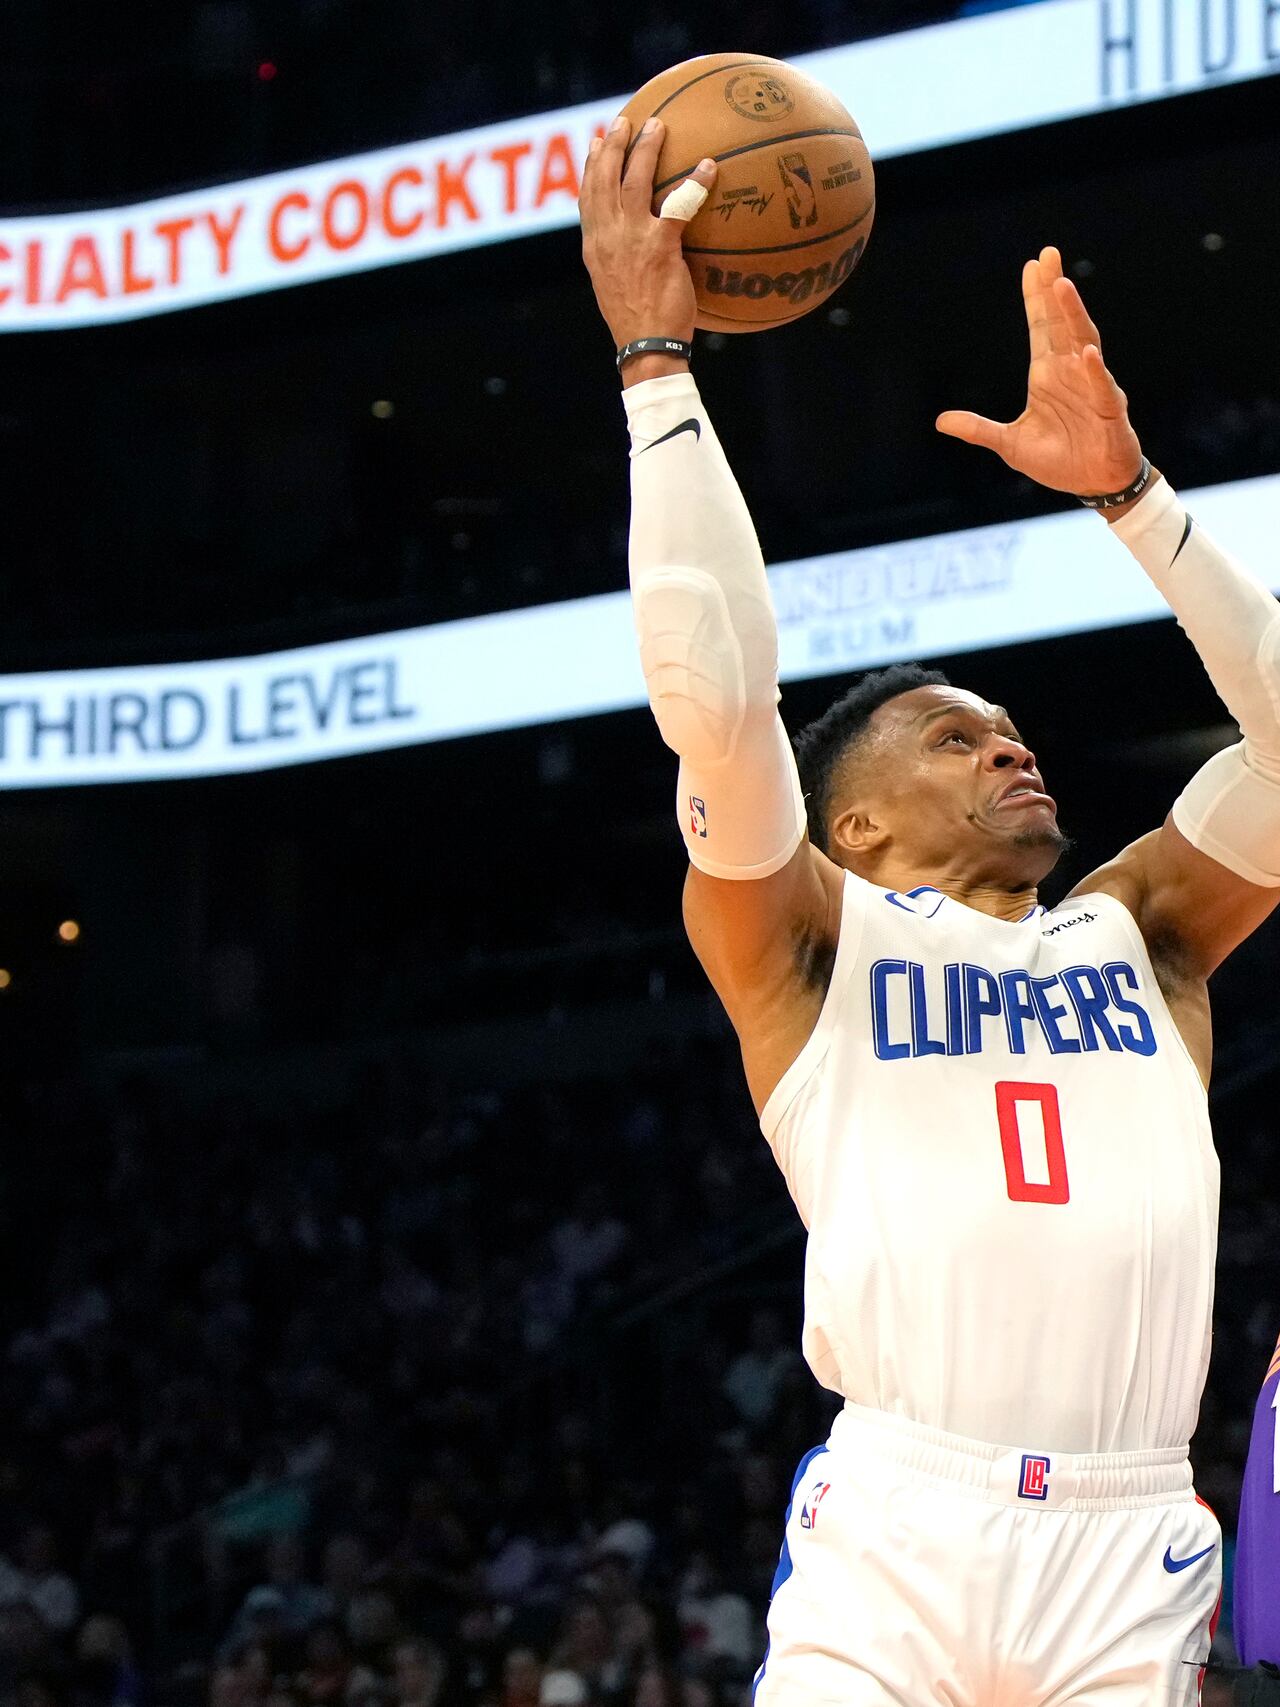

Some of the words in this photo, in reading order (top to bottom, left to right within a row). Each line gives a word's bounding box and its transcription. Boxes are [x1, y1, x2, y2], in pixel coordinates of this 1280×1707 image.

[705, 235, 865, 305] Wilson
[776, 530, 1023, 625] NDUAY
[0, 684, 208, 760] THIRD
[228, 655, 416, 746] LEVEL
[1041, 912, 1099, 937] oney
[869, 958, 1158, 1061] CLIPPERS
[994, 1080, 1071, 1205] 0
